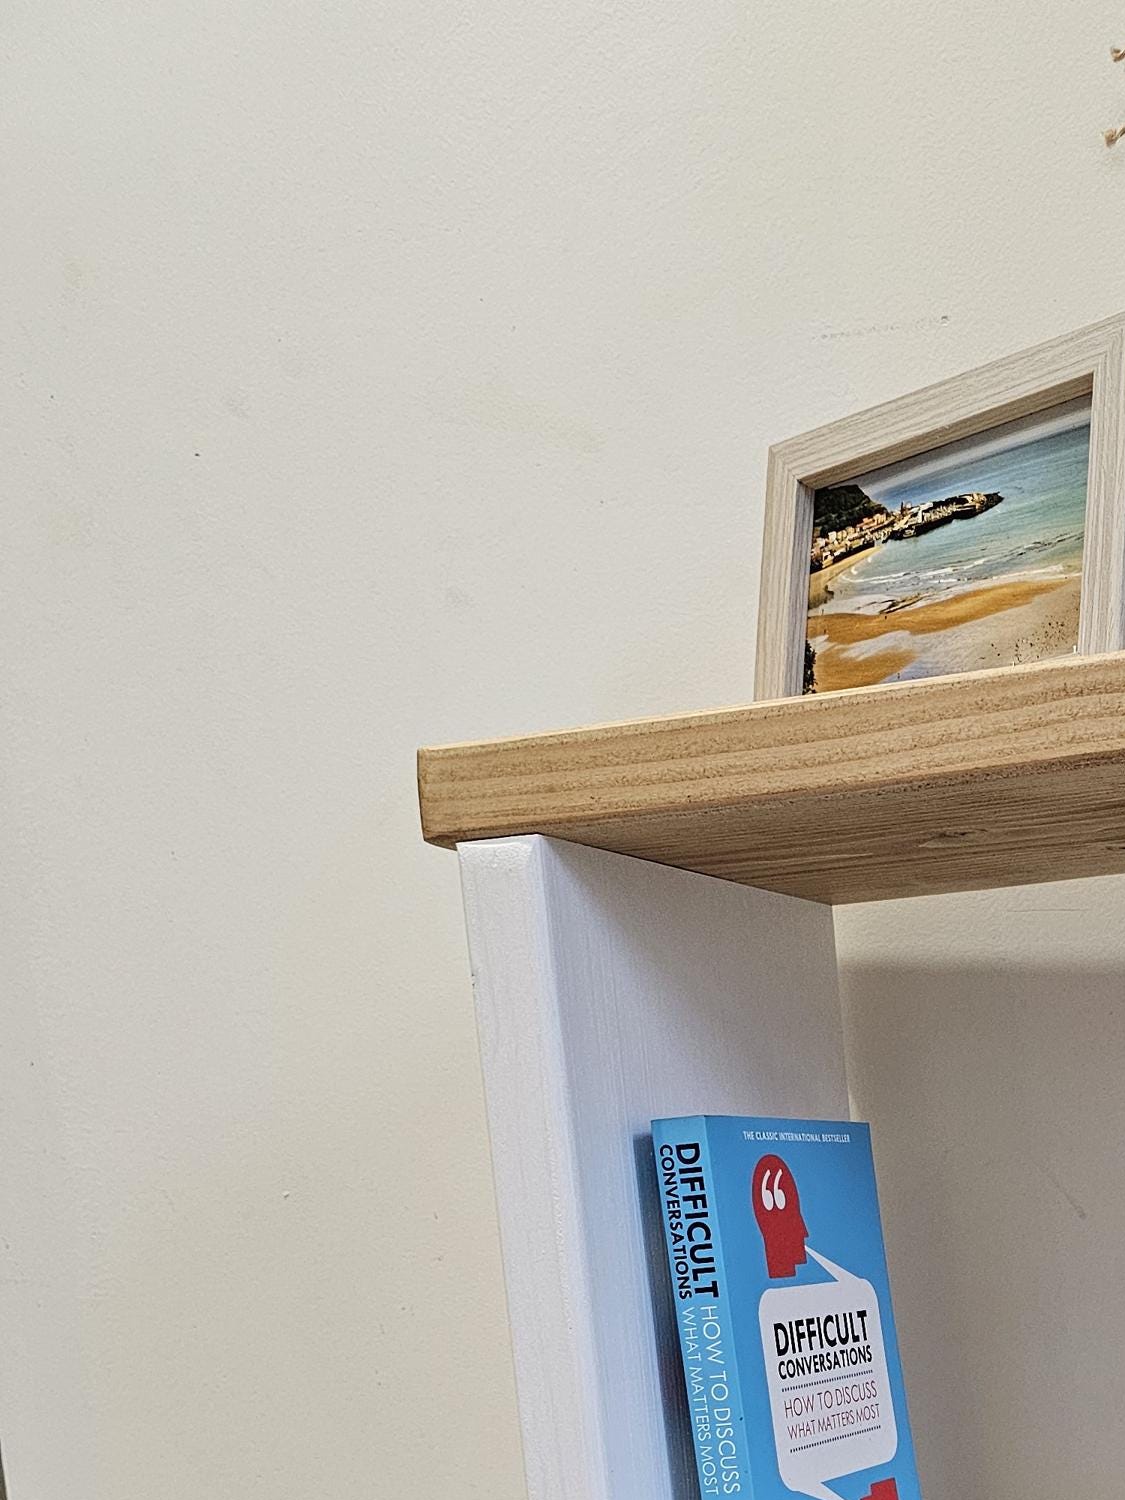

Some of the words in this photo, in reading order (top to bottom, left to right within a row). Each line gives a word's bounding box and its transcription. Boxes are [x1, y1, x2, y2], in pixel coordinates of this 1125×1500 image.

[742, 1130, 754, 1140] THE
[755, 1131, 778, 1141] CLASSIC
[779, 1132, 820, 1142] INTERNATIONAL
[821, 1134, 850, 1143] BESTSELLER
[659, 1144, 692, 1300] CONVERSATIONS
[675, 1143, 719, 1298] DIFFICULT
[682, 1307, 702, 1362] WHAT
[700, 1305, 725, 1365] HOW
[773, 1310, 868, 1357] DIFFICULT
[709, 1370, 729, 1401] TO
[778, 1345, 873, 1380] CONVERSATIONS
[689, 1366, 711, 1442] MATTERS
[783, 1394, 815, 1419] HOW
[817, 1390, 834, 1410] TO
[835, 1380, 878, 1406] DISCUSS
[787, 1419, 816, 1441] WHAT
[817, 1409, 855, 1432] MATTERS
[856, 1403, 880, 1426] MOST
[699, 1446, 719, 1495] MOST
[714, 1407, 741, 1494] DISCUSS
